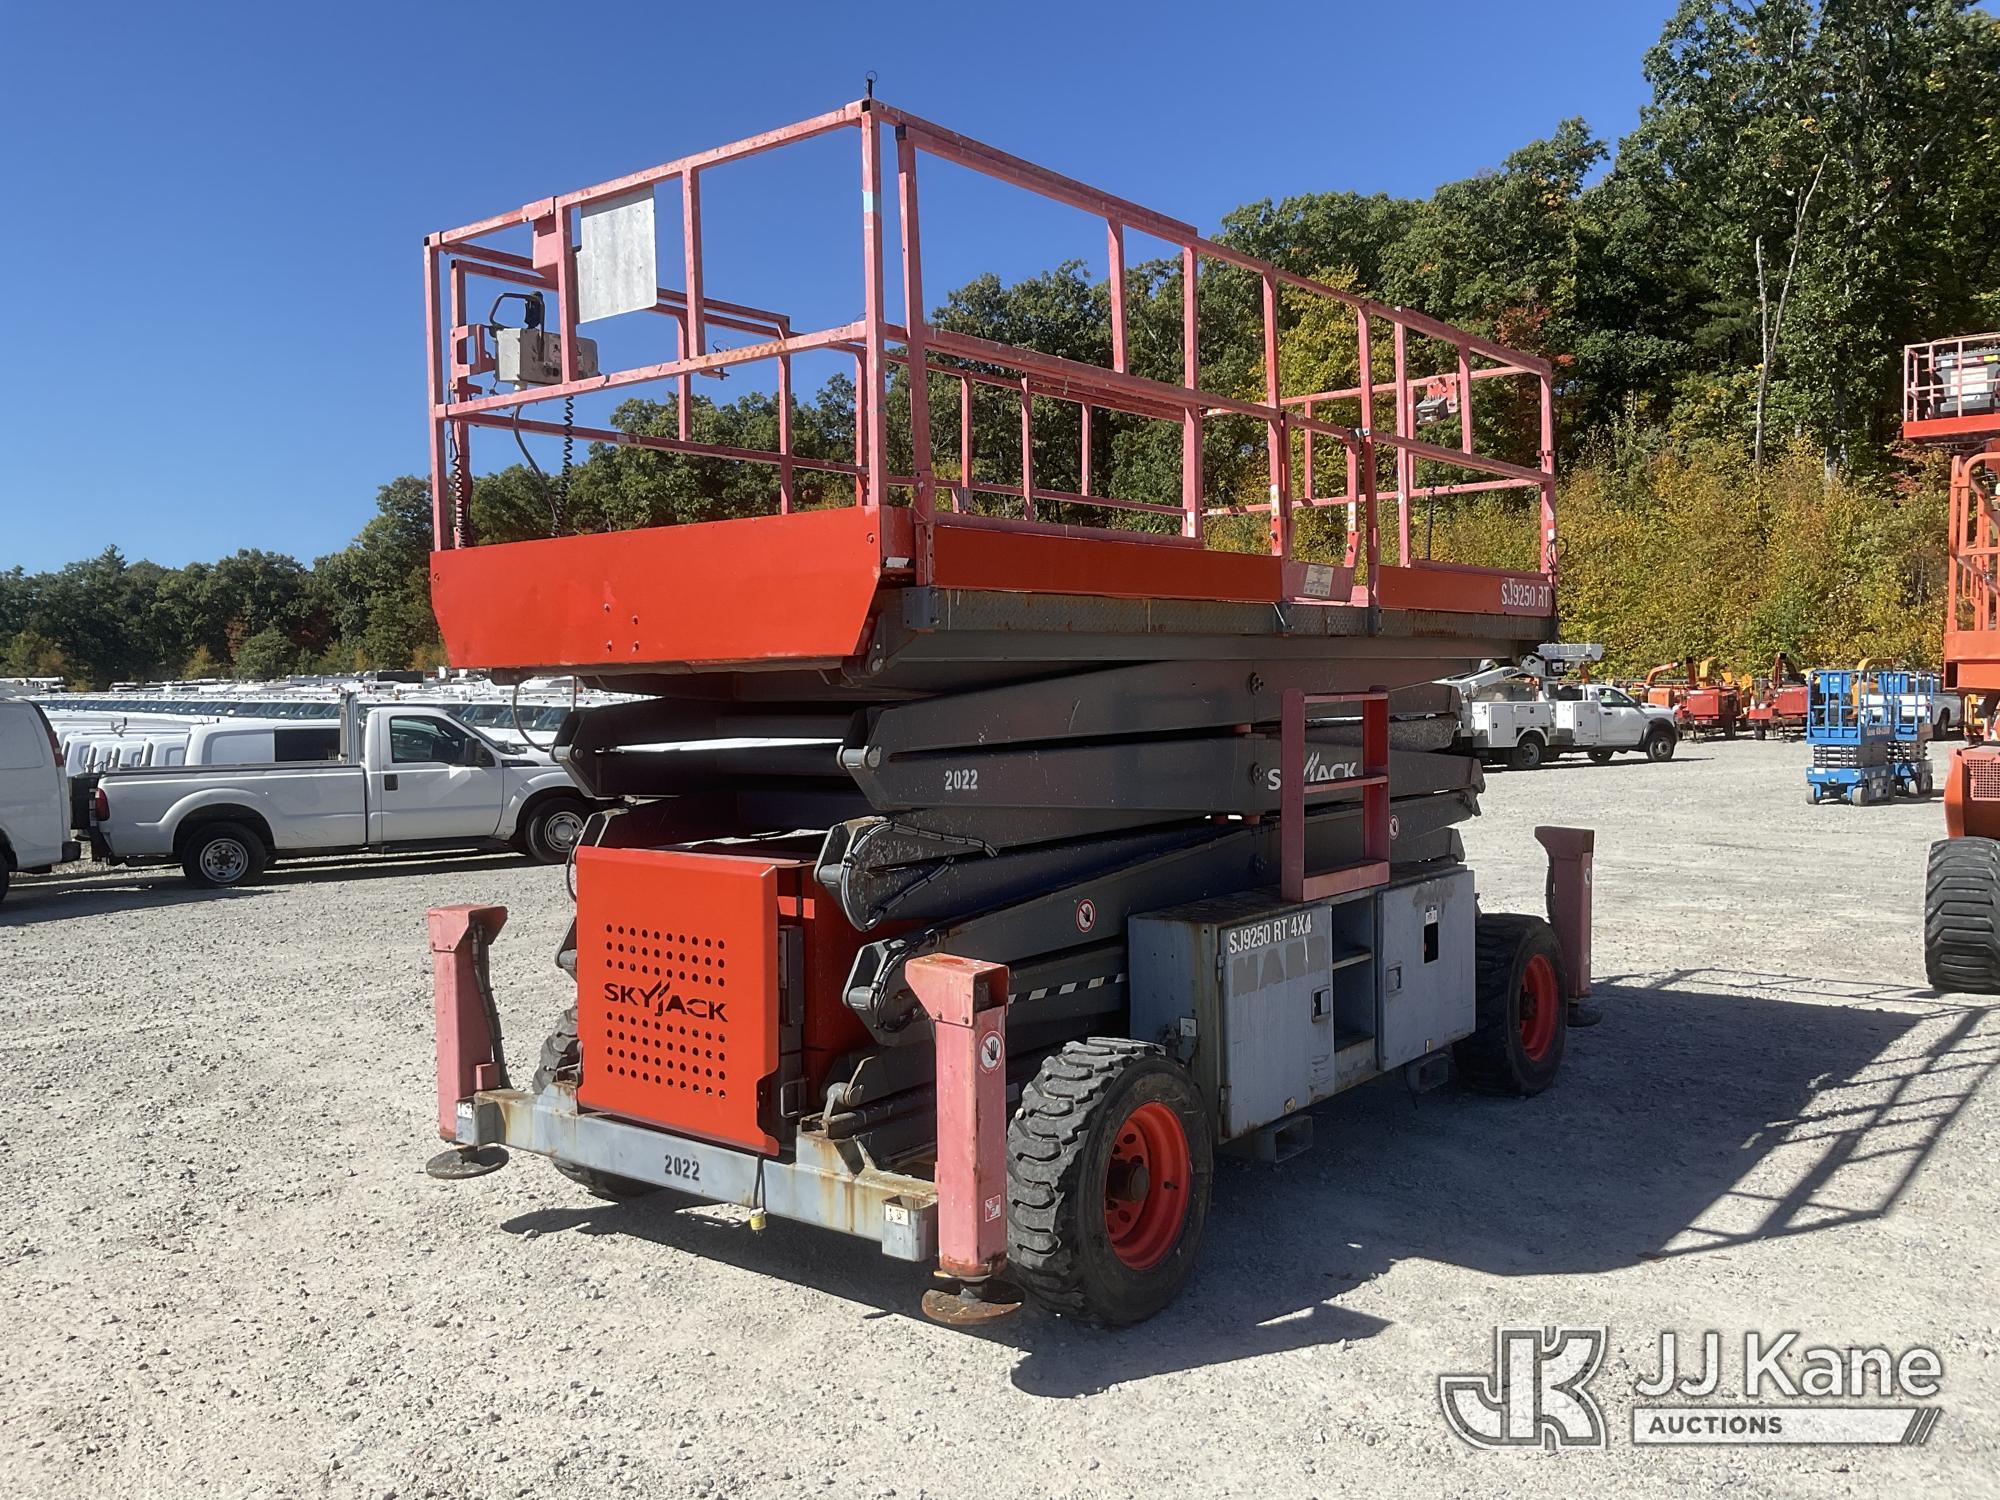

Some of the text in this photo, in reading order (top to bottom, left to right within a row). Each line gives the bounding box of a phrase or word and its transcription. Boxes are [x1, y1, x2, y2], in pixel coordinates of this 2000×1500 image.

[1501, 577, 1550, 608] SJ9250 RT
[945, 769, 978, 790] 2022
[1229, 912, 1312, 954] SJ9250 RT 4X4
[604, 980, 728, 1022] SKYJACK
[664, 1154, 700, 1181] 2022
